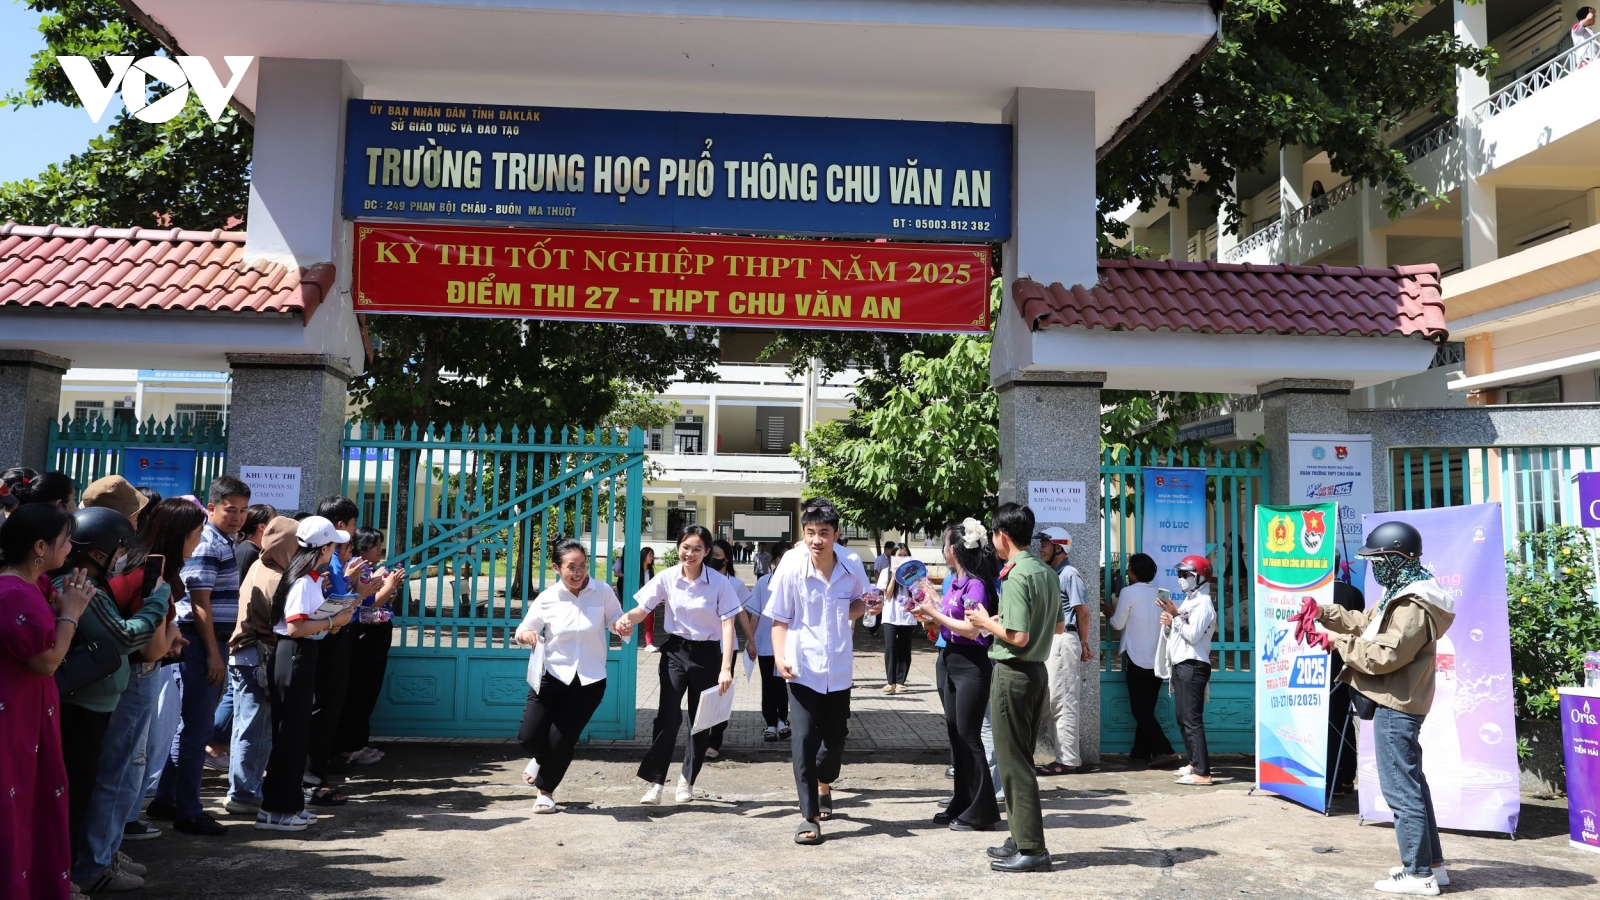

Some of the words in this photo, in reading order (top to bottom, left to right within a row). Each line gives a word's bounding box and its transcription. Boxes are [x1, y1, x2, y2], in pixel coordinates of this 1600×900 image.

[370, 102, 383, 115] ỦY
[388, 106, 408, 116] BAN
[414, 106, 441, 118] NHÂN
[446, 107, 466, 118] DÂN
[472, 106, 494, 120] TỈNH
[391, 117, 405, 131] SỞ
[409, 120, 432, 132] GIÁO
[438, 123, 456, 136] DỤC
[461, 122, 472, 134] VÀ
[502, 126, 519, 138] TẠO
[366, 138, 482, 189] TRƯỜNG
[492, 152, 585, 192] TRUNG
[594, 155, 650, 203] HỌC
[658, 138, 715, 198] PHỔ
[724, 152, 818, 201] THÔNG
[826, 164, 880, 204] CHU
[890, 158, 942, 206] VĂN
[952, 170, 991, 208] AN
[387, 201, 405, 211] 249
[410, 202, 435, 212] PHAN
[440, 200, 456, 215] BỘI
[461, 201, 486, 214] CHÂU
[495, 202, 522, 215] BUÔN
[528, 206, 543, 216] MA
[971, 221, 990, 231] 382
[375, 236, 425, 264] KỲ
[434, 244, 495, 267] THI
[505, 238, 574, 270] TỐT
[583, 247, 714, 280] NGHIỆP
[723, 254, 812, 279] THPT
[821, 254, 898, 282] NĂM
[906, 262, 972, 285] 2025
[446, 272, 521, 305] ĐIỂM
[531, 284, 575, 308] THI
[585, 287, 620, 309] 27
[650, 288, 719, 314] THPT
[728, 291, 785, 316] CHU
[795, 289, 852, 318] VĂN
[861, 296, 901, 320] AN
[1051, 487, 1066, 495] VỰC
[1296, 658, 1325, 685] 2025
